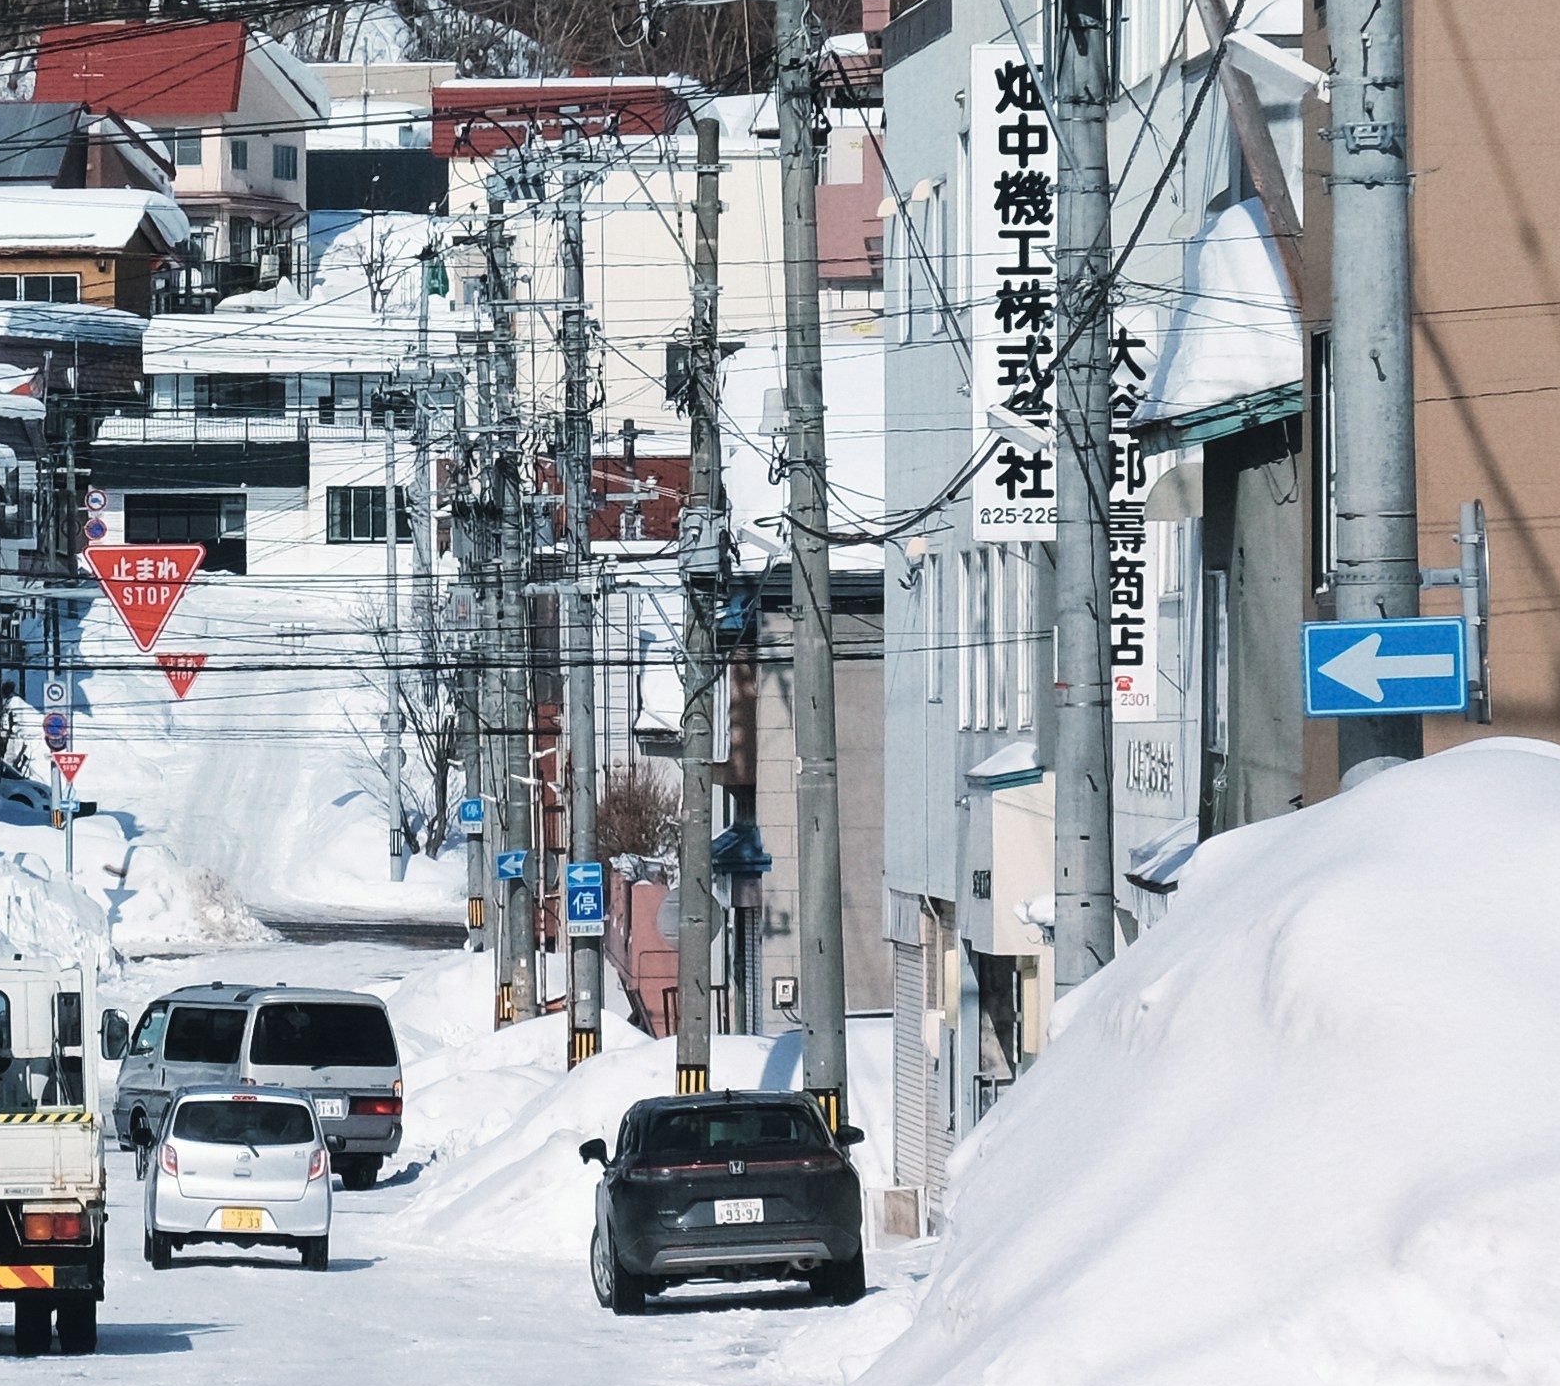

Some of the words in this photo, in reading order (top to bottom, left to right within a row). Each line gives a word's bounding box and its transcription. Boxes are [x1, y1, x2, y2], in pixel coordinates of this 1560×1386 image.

[110, 556, 180, 581] 止まれ
[122, 586, 170, 606] STOP
[572, 891, 598, 916] 停
